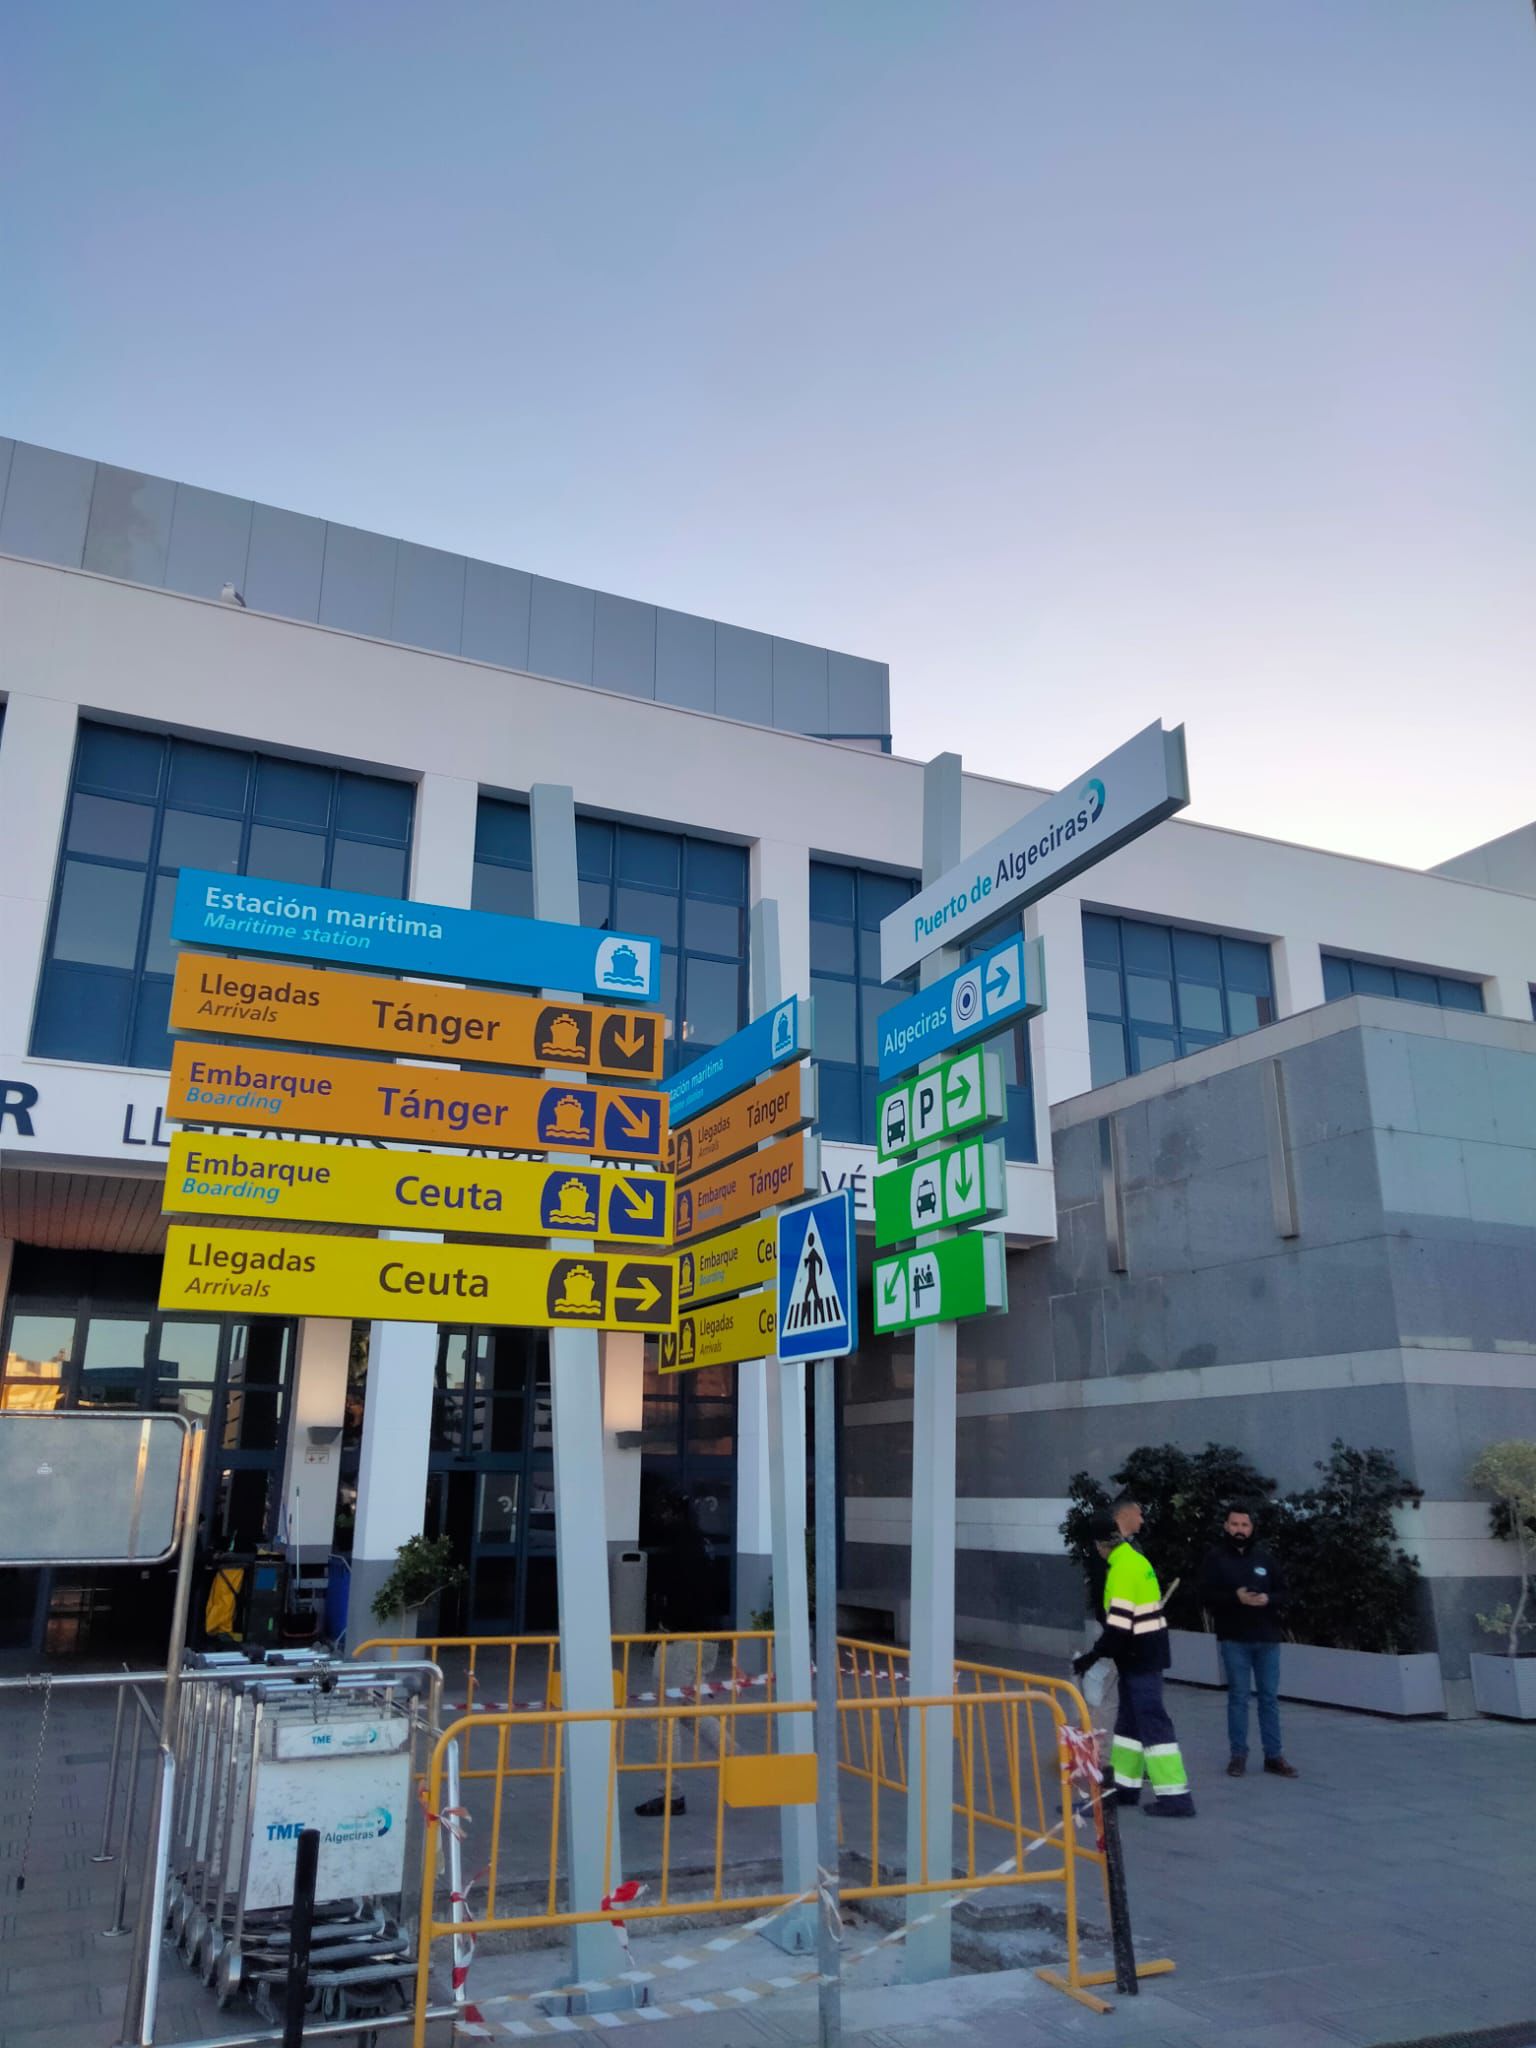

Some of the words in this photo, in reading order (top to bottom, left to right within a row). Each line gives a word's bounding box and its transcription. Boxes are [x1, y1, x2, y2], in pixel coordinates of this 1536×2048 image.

[914, 893, 967, 943] Puerto
[971, 875, 992, 904] de
[995, 809, 1088, 889] Algeciras
[203, 912, 297, 939] Maritime
[301, 926, 371, 949] station
[206, 887, 317, 922] Estación
[326, 907, 443, 940] marítima
[200, 973, 320, 1006] Llegadas
[197, 1000, 278, 1023] Arrivals
[372, 1000, 500, 1044] Tánger
[884, 1006, 947, 1057] Algeciras
[190, 1061, 332, 1098] Embarque
[691, 1058, 724, 1088] marítima
[186, 1087, 282, 1114] Boarding
[377, 1086, 509, 1131] Tánger
[746, 1091, 790, 1129] Tánger
[920, 1088, 934, 1129] P
[698, 1117, 731, 1143] Llegadas
[186, 1151, 331, 1187] Embarque
[698, 1180, 737, 1207] Embarque
[749, 1161, 794, 1197] Tánger
[182, 1177, 280, 1204] Boarding
[395, 1175, 503, 1211] Ceuta
[188, 1243, 316, 1275] Llegadas
[700, 1247, 738, 1271] Embarque
[184, 1277, 271, 1298] Arrivals
[379, 1262, 489, 1298] Ceuta
[700, 1313, 734, 1338] Llegadas
[312, 1735, 332, 1745] TME
[324, 1830, 374, 1844] Algeciras
